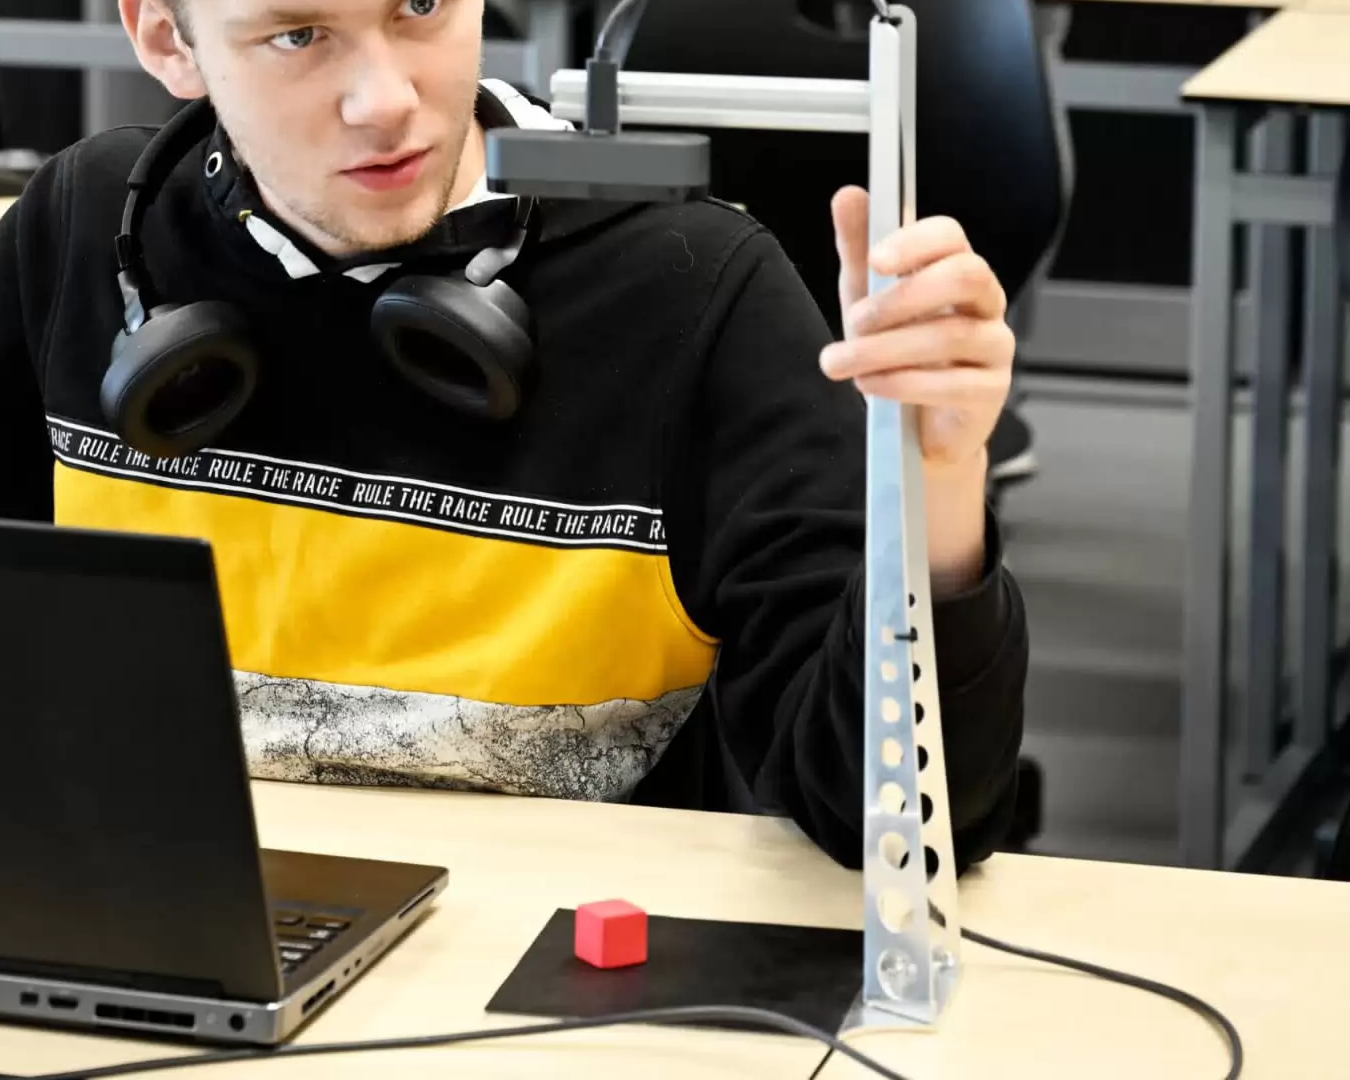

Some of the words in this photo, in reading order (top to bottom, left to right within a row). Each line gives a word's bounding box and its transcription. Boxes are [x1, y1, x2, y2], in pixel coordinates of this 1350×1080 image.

[50, 427, 73, 452] RACE
[78, 436, 123, 463] RULE
[155, 456, 202, 476] RACE
[208, 458, 256, 483] RULE
[261, 466, 291, 489] THE
[291, 471, 343, 498] RACE
[352, 482, 395, 506] RULE
[399, 487, 437, 512] THE
[439, 495, 492, 522] RACE
[499, 505, 551, 531] RULE
[555, 513, 589, 535] THE
[590, 514, 638, 535] RACE
